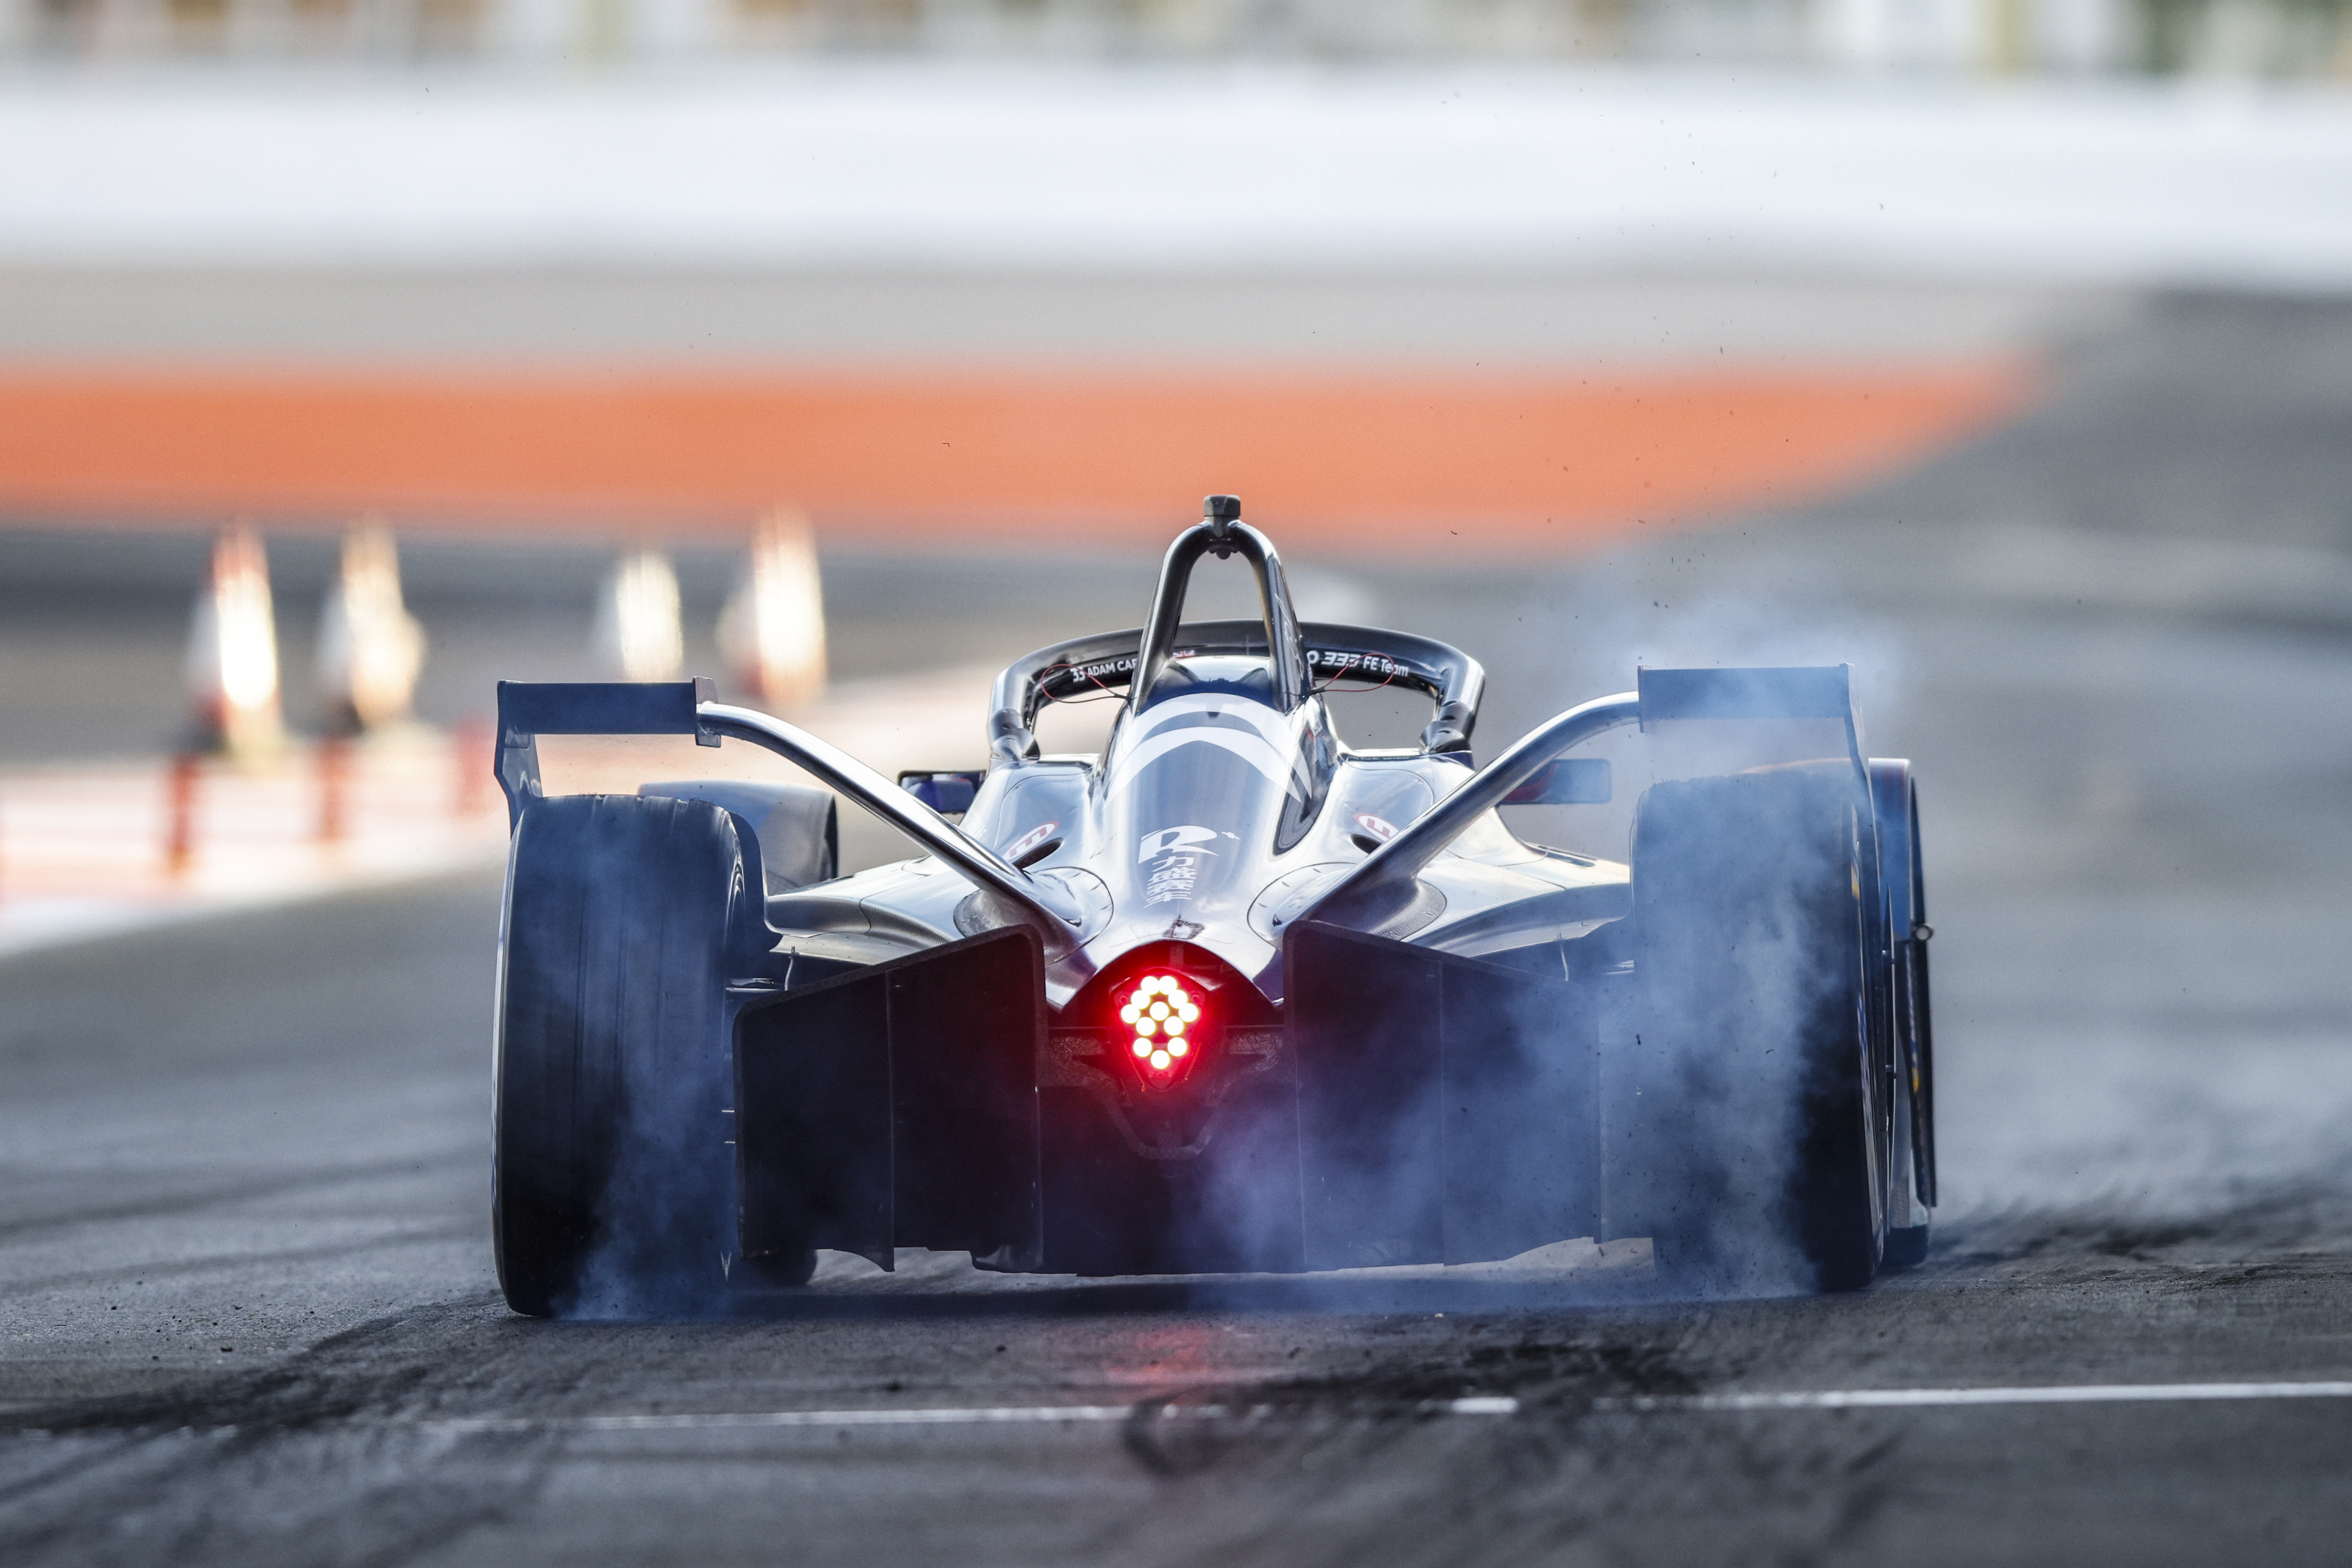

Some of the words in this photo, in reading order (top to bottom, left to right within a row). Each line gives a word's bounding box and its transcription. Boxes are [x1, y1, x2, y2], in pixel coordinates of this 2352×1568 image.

[1070, 666, 1086, 683] 33
[1087, 663, 1116, 677] ADAM
[1321, 651, 1361, 667] 333
[1363, 656, 1380, 671] FE
[1381, 659, 1409, 677] Team
